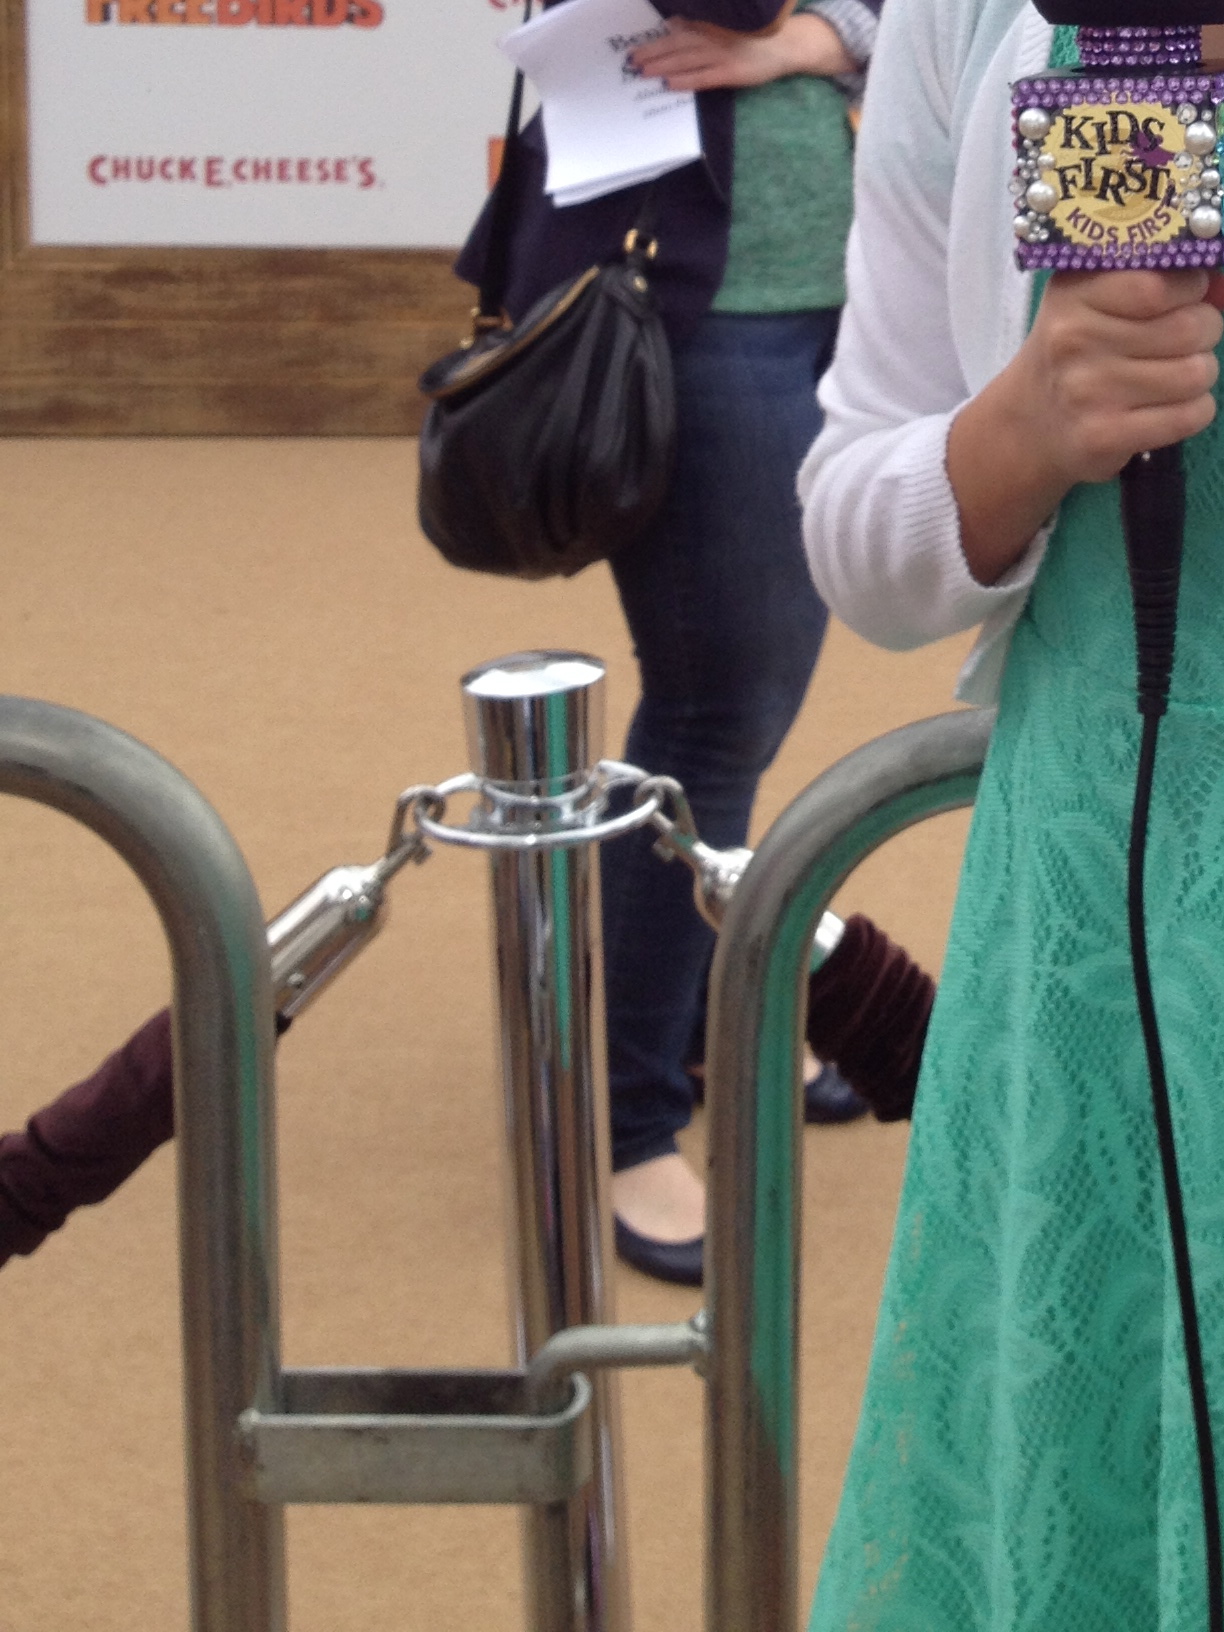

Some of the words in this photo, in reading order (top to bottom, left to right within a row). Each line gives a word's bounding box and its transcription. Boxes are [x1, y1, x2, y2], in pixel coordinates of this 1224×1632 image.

[1060, 110, 1165, 156] KIDS
[86, 154, 198, 187] CHUCK
[230, 156, 377, 191] CHEESE'S
[1065, 207, 1119, 244] KIDS
